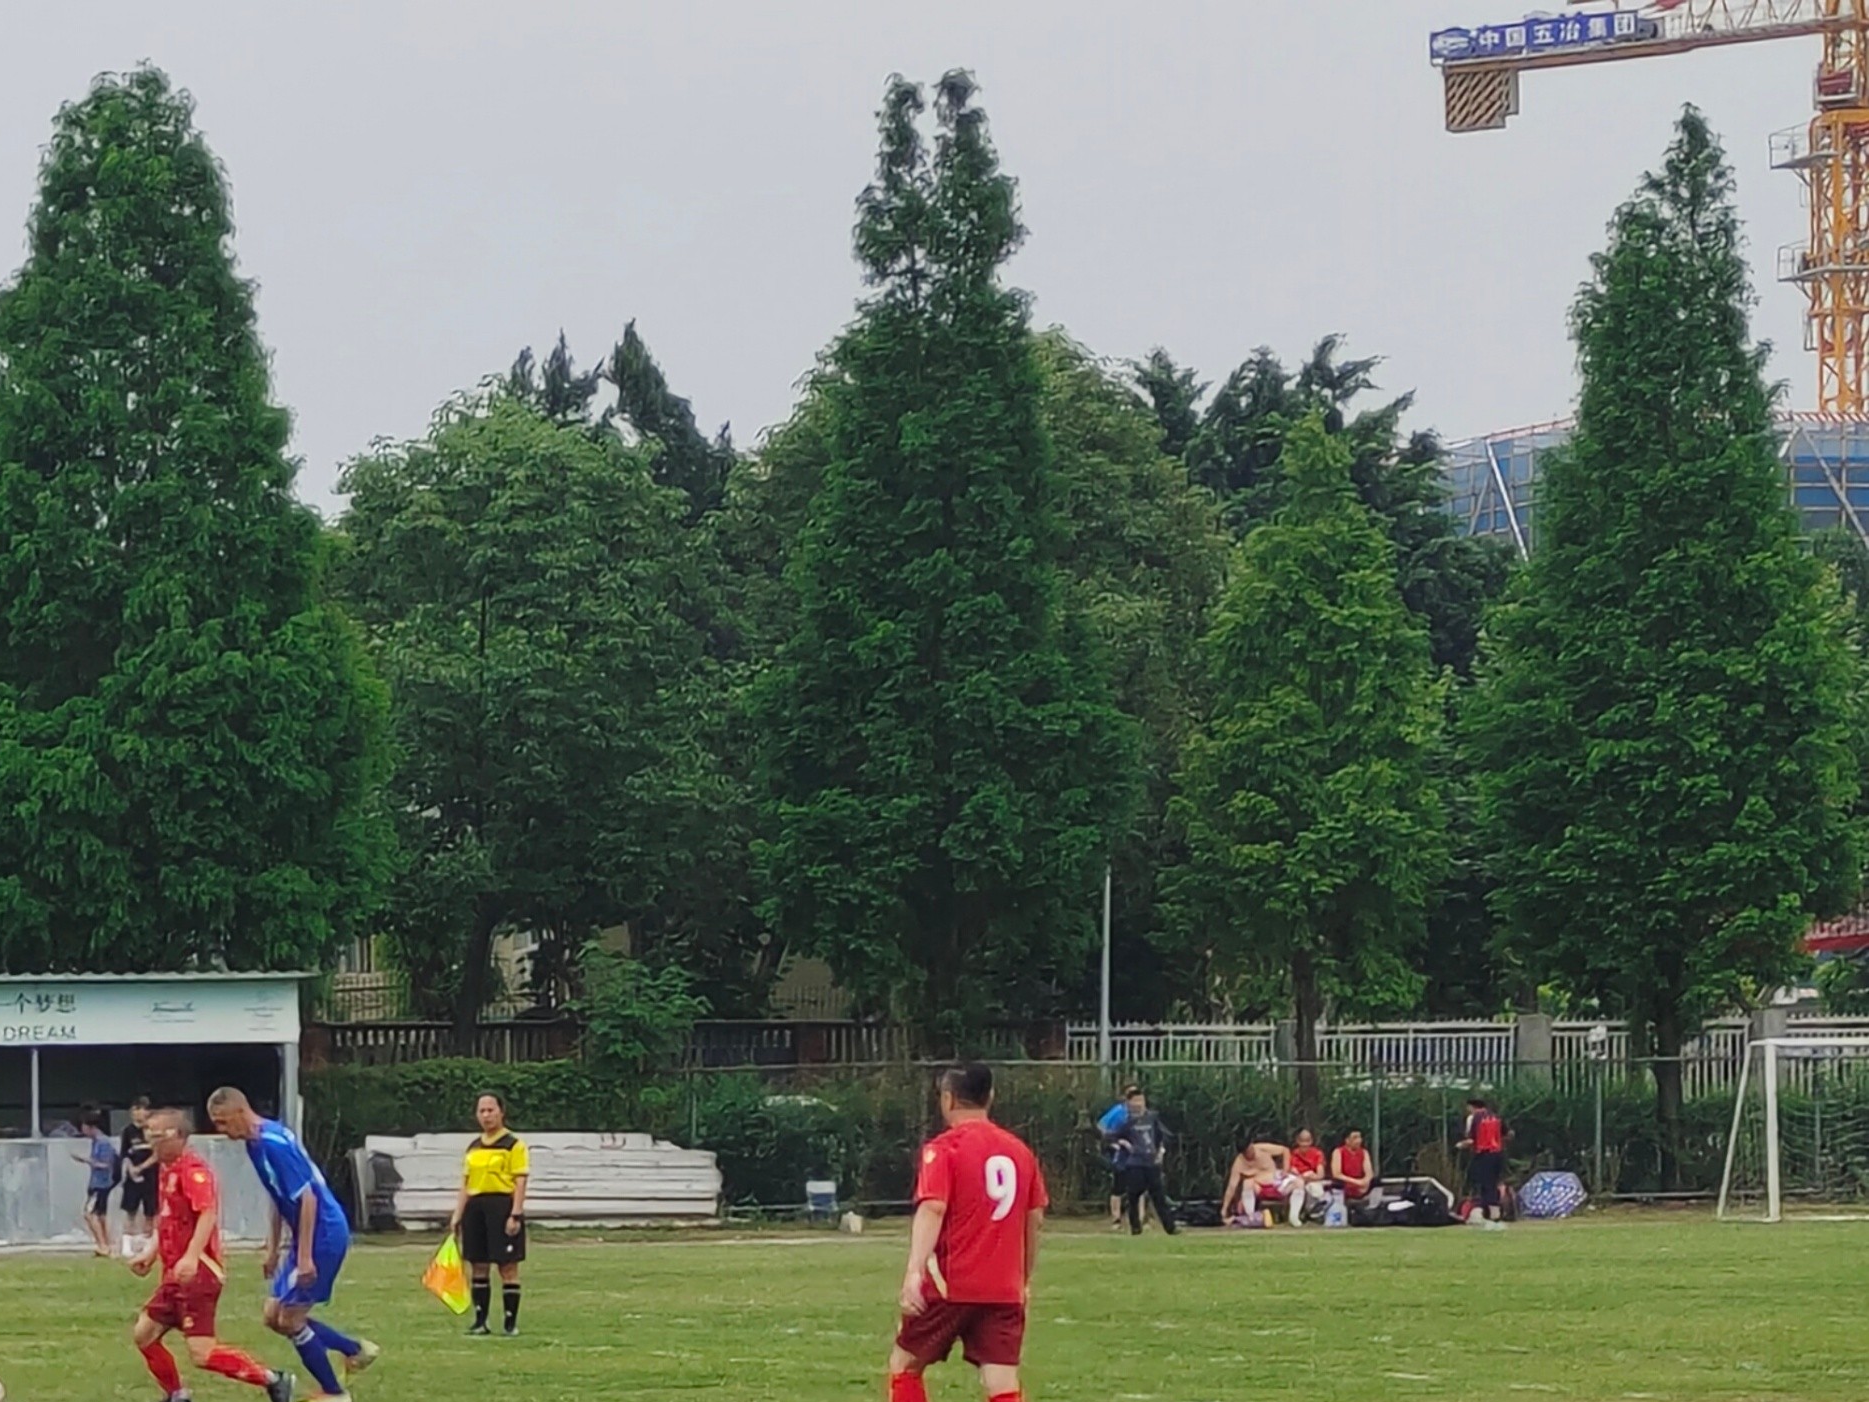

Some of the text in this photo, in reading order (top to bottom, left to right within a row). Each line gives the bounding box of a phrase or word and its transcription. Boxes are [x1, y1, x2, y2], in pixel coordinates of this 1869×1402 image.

[1479, 12, 1636, 50] 中国五冶集团
[3, 1025, 77, 1041] DREAM
[985, 1155, 1017, 1221] 9
